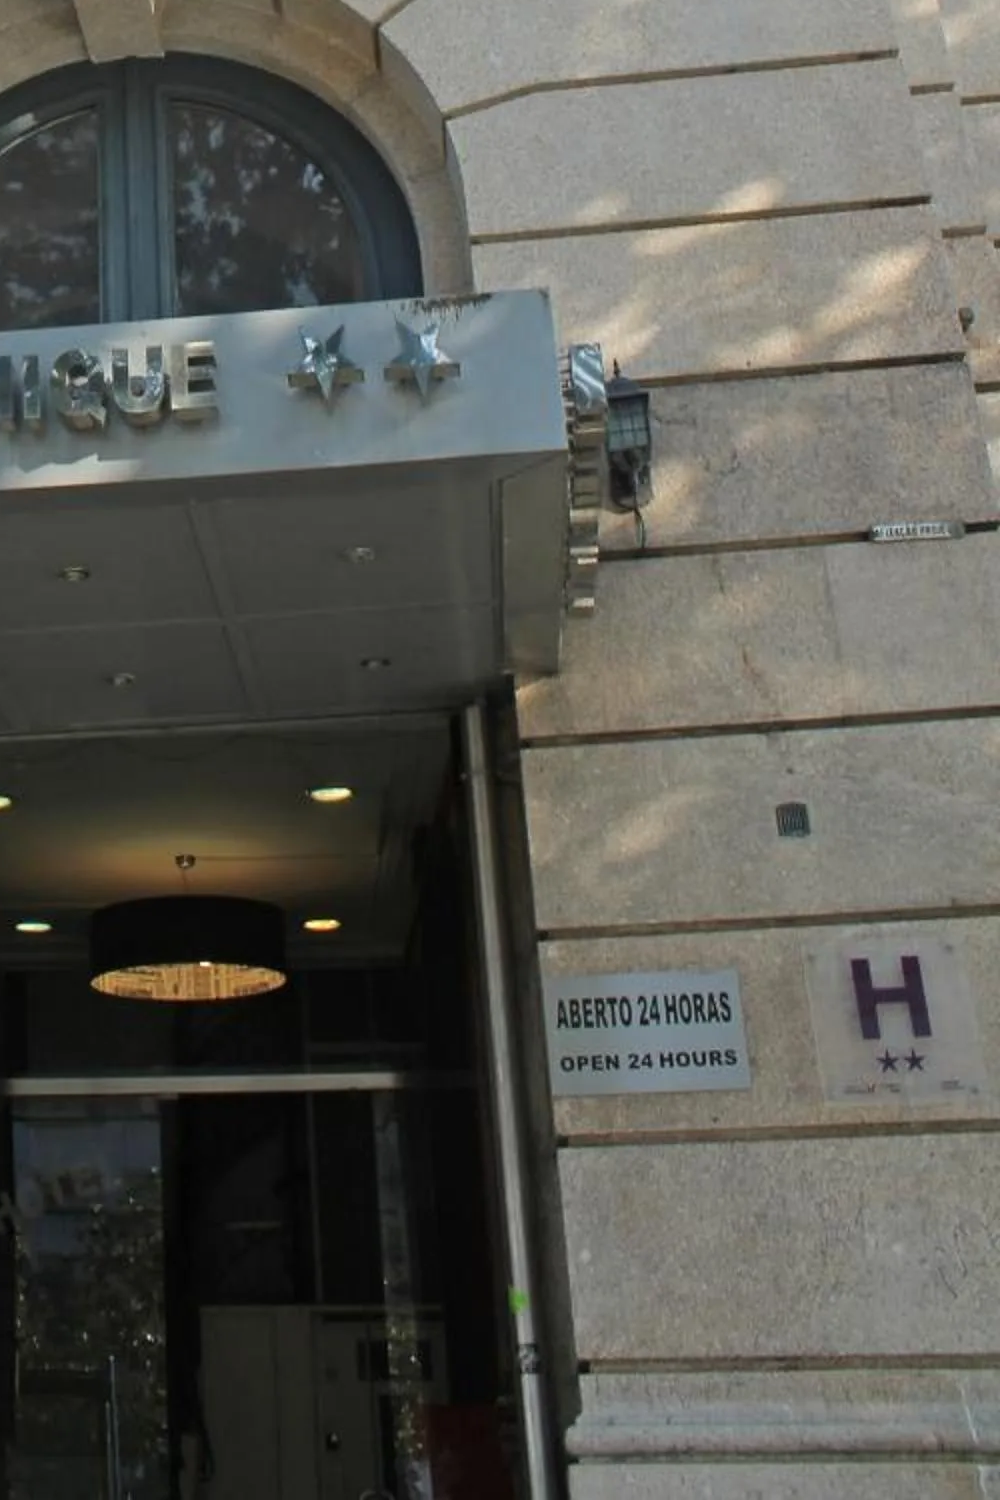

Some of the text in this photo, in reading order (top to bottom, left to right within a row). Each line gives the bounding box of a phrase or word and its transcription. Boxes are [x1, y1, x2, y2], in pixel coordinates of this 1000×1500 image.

[557, 991, 732, 1029] ABERTO 24 HORAS
[850, 955, 932, 1040] H
[560, 1049, 738, 1073] OPEN 24 HOURS
